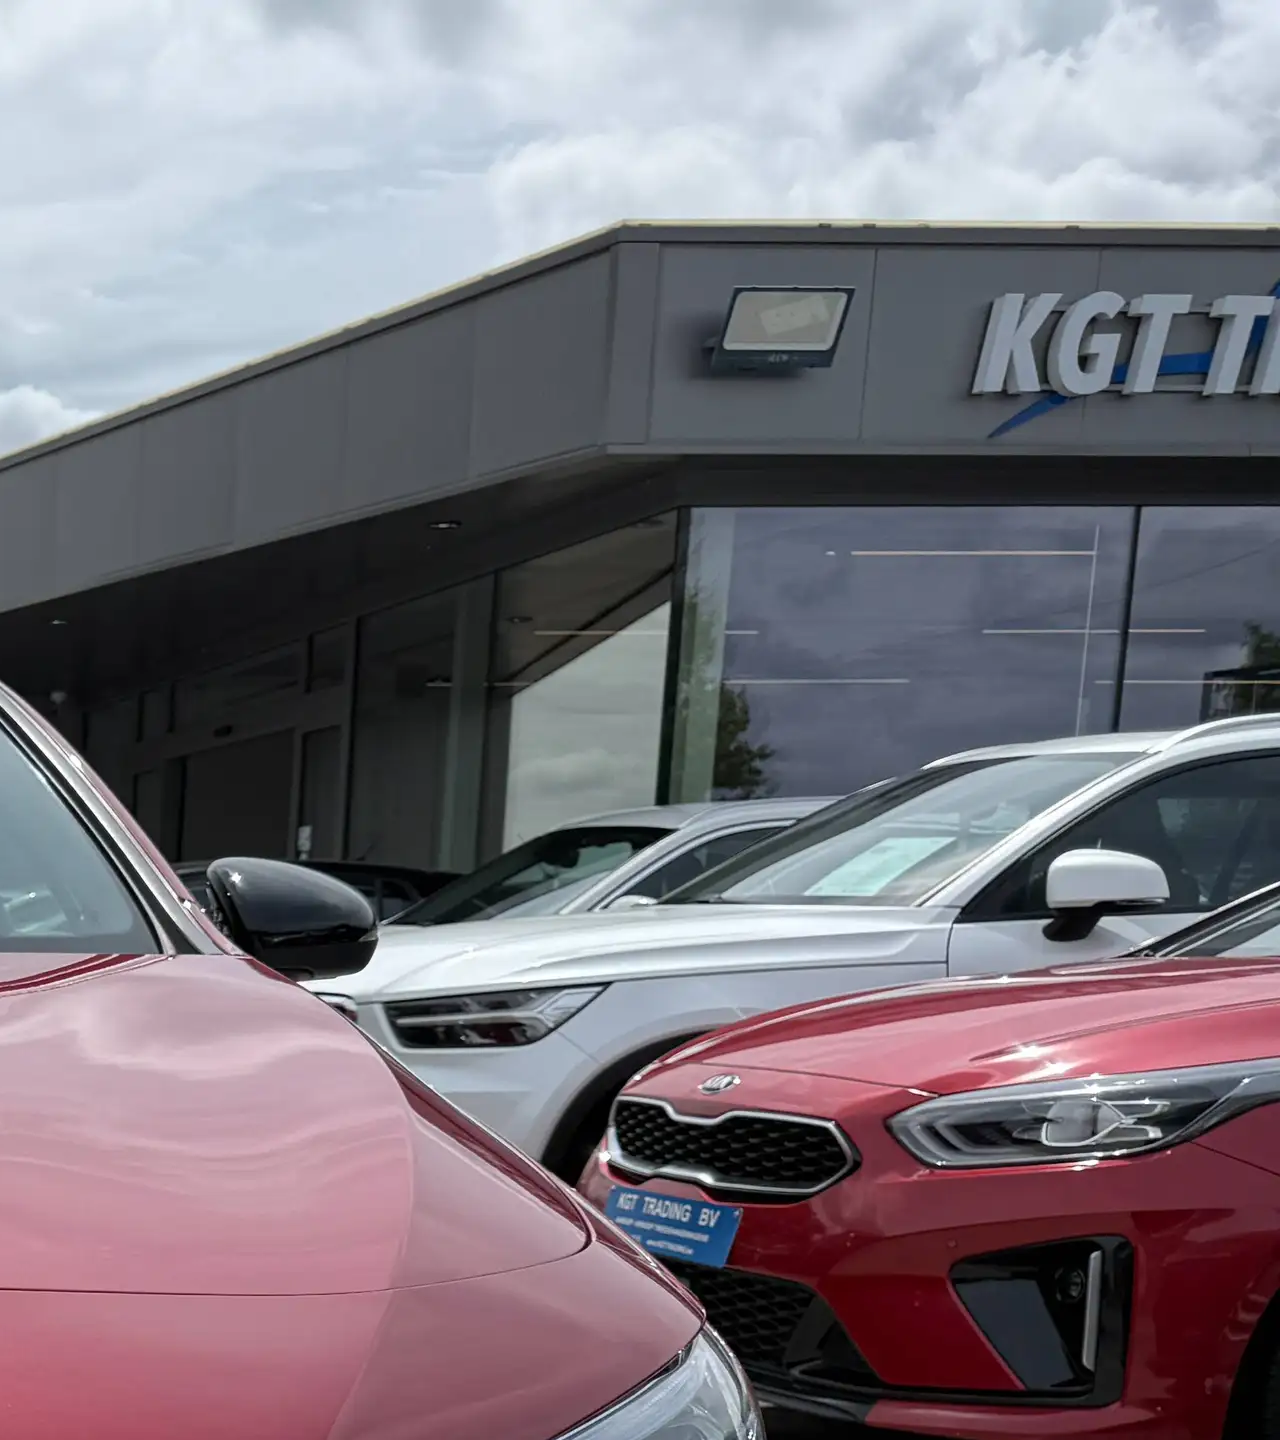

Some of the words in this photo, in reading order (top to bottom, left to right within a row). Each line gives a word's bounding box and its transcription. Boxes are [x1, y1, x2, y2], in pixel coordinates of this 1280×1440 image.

[972, 290, 1193, 398] KGT
[617, 1193, 640, 1210] KGT
[643, 1197, 691, 1221] TRADING
[697, 1207, 721, 1228] BV
